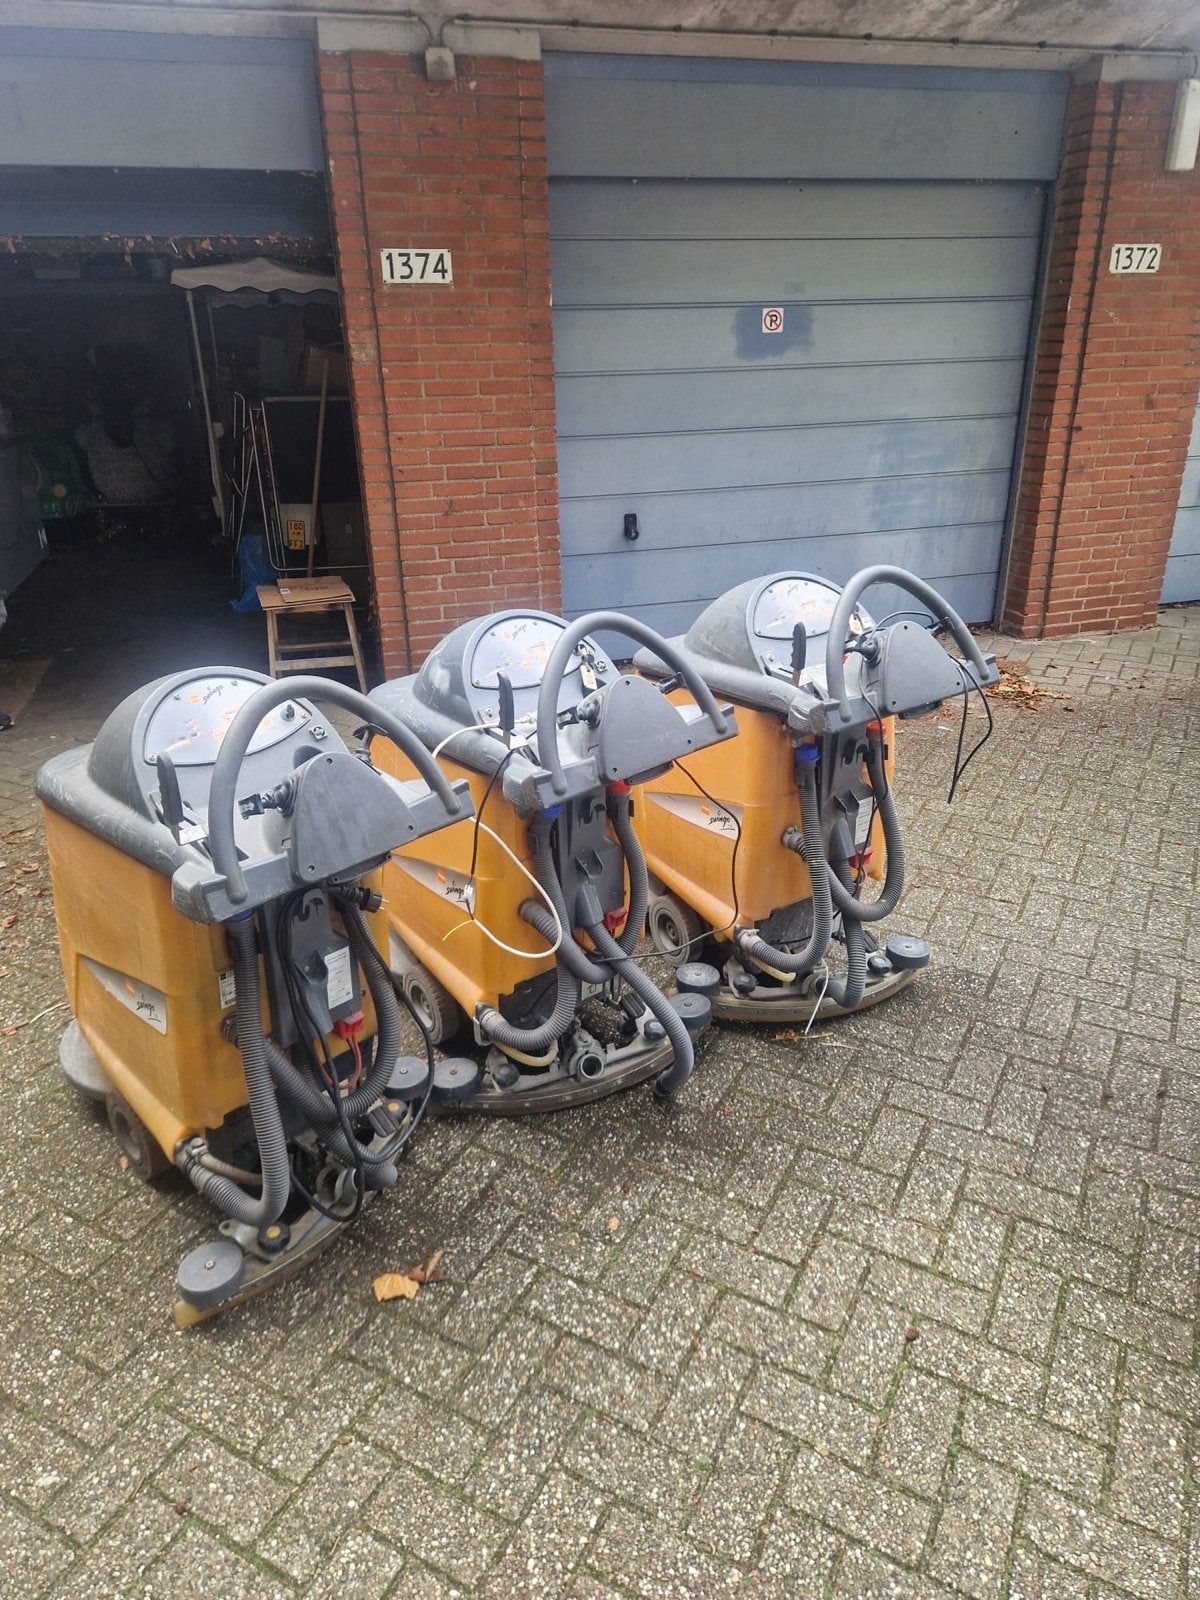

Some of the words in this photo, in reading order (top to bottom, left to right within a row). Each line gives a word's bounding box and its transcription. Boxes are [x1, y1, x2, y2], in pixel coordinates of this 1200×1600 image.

[386, 253, 448, 279] 1374
[1115, 247, 1158, 270] 1372
[203, 685, 224, 705] swingo
[707, 810, 731, 828] swingo
